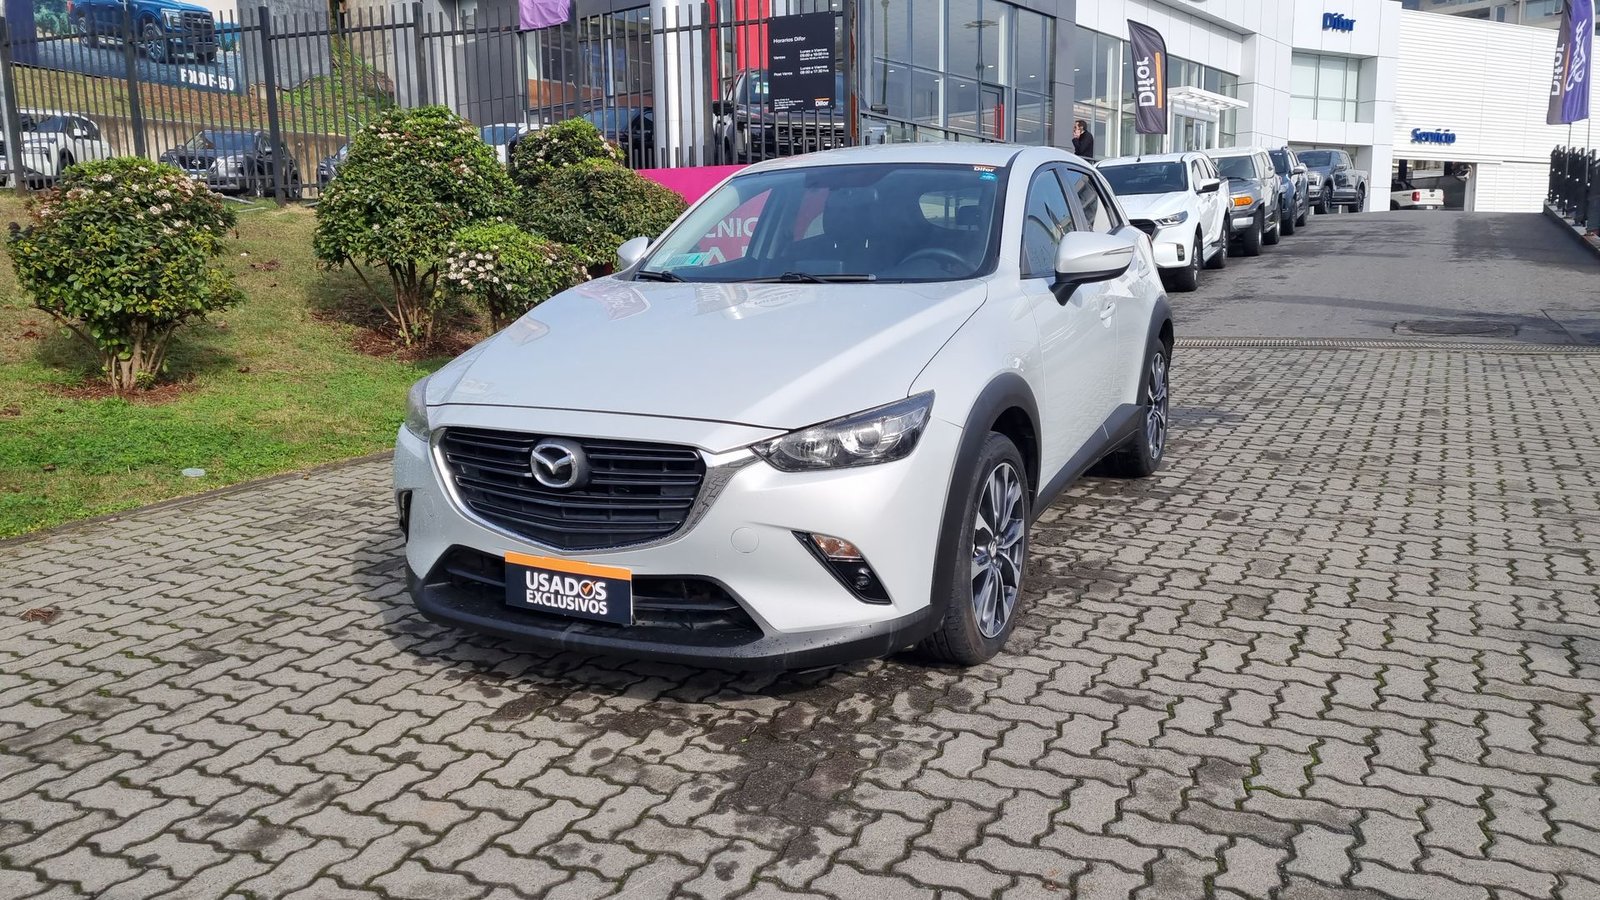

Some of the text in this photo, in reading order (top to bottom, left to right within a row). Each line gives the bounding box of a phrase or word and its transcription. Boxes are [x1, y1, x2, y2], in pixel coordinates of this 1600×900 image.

[1322, 12, 1356, 31] Difor
[1411, 128, 1456, 144] Servicio
[525, 570, 607, 601] USADOS
[526, 589, 608, 615] EXCLUSIVOS
